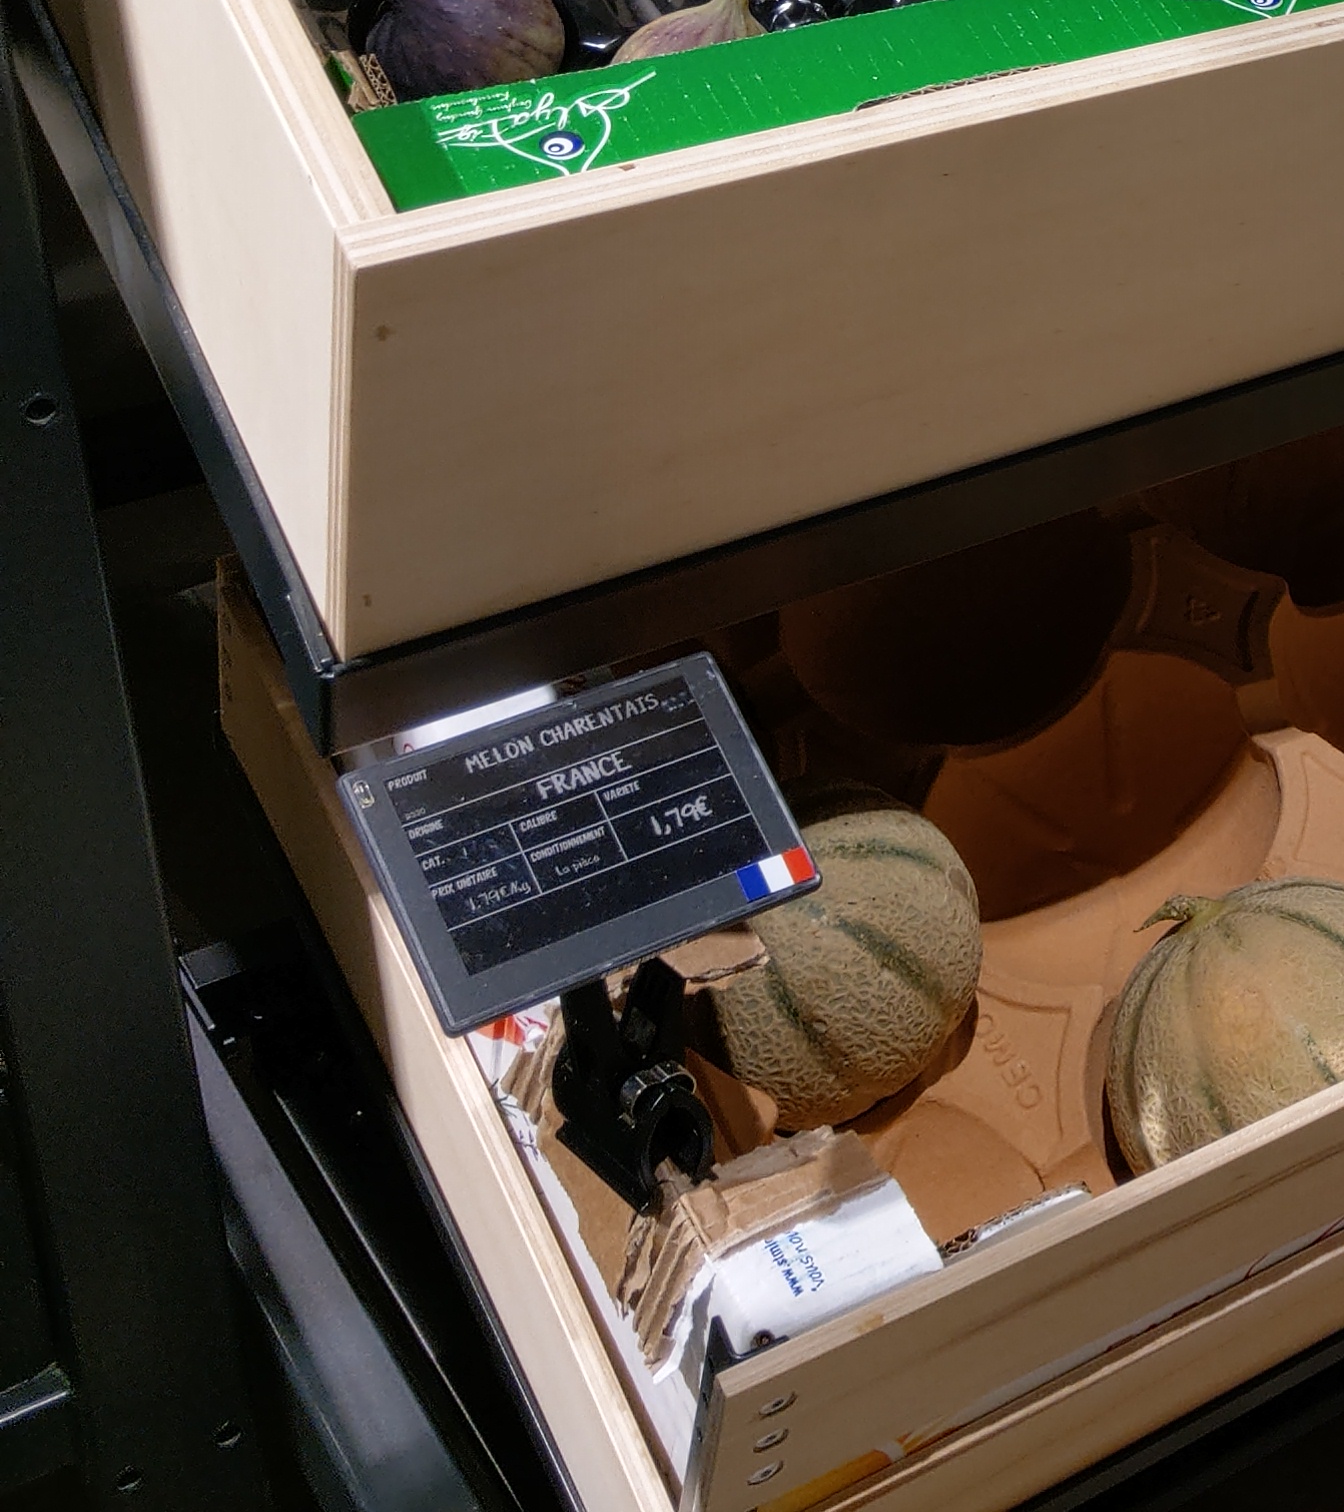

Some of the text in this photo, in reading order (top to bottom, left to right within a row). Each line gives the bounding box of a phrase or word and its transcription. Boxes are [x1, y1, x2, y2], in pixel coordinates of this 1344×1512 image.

[465, 693, 660, 774] MELON CHARENTAIS
[387, 769, 427, 791] PRODUIT
[408, 751, 632, 840] ORIGINE FRANCE
[651, 795, 713, 836] 1,79€
[421, 780, 641, 871] CAT. CALIBRE VARIETE
[431, 826, 606, 900] PRIX UNITAIRE CONDITIONNEMENT
